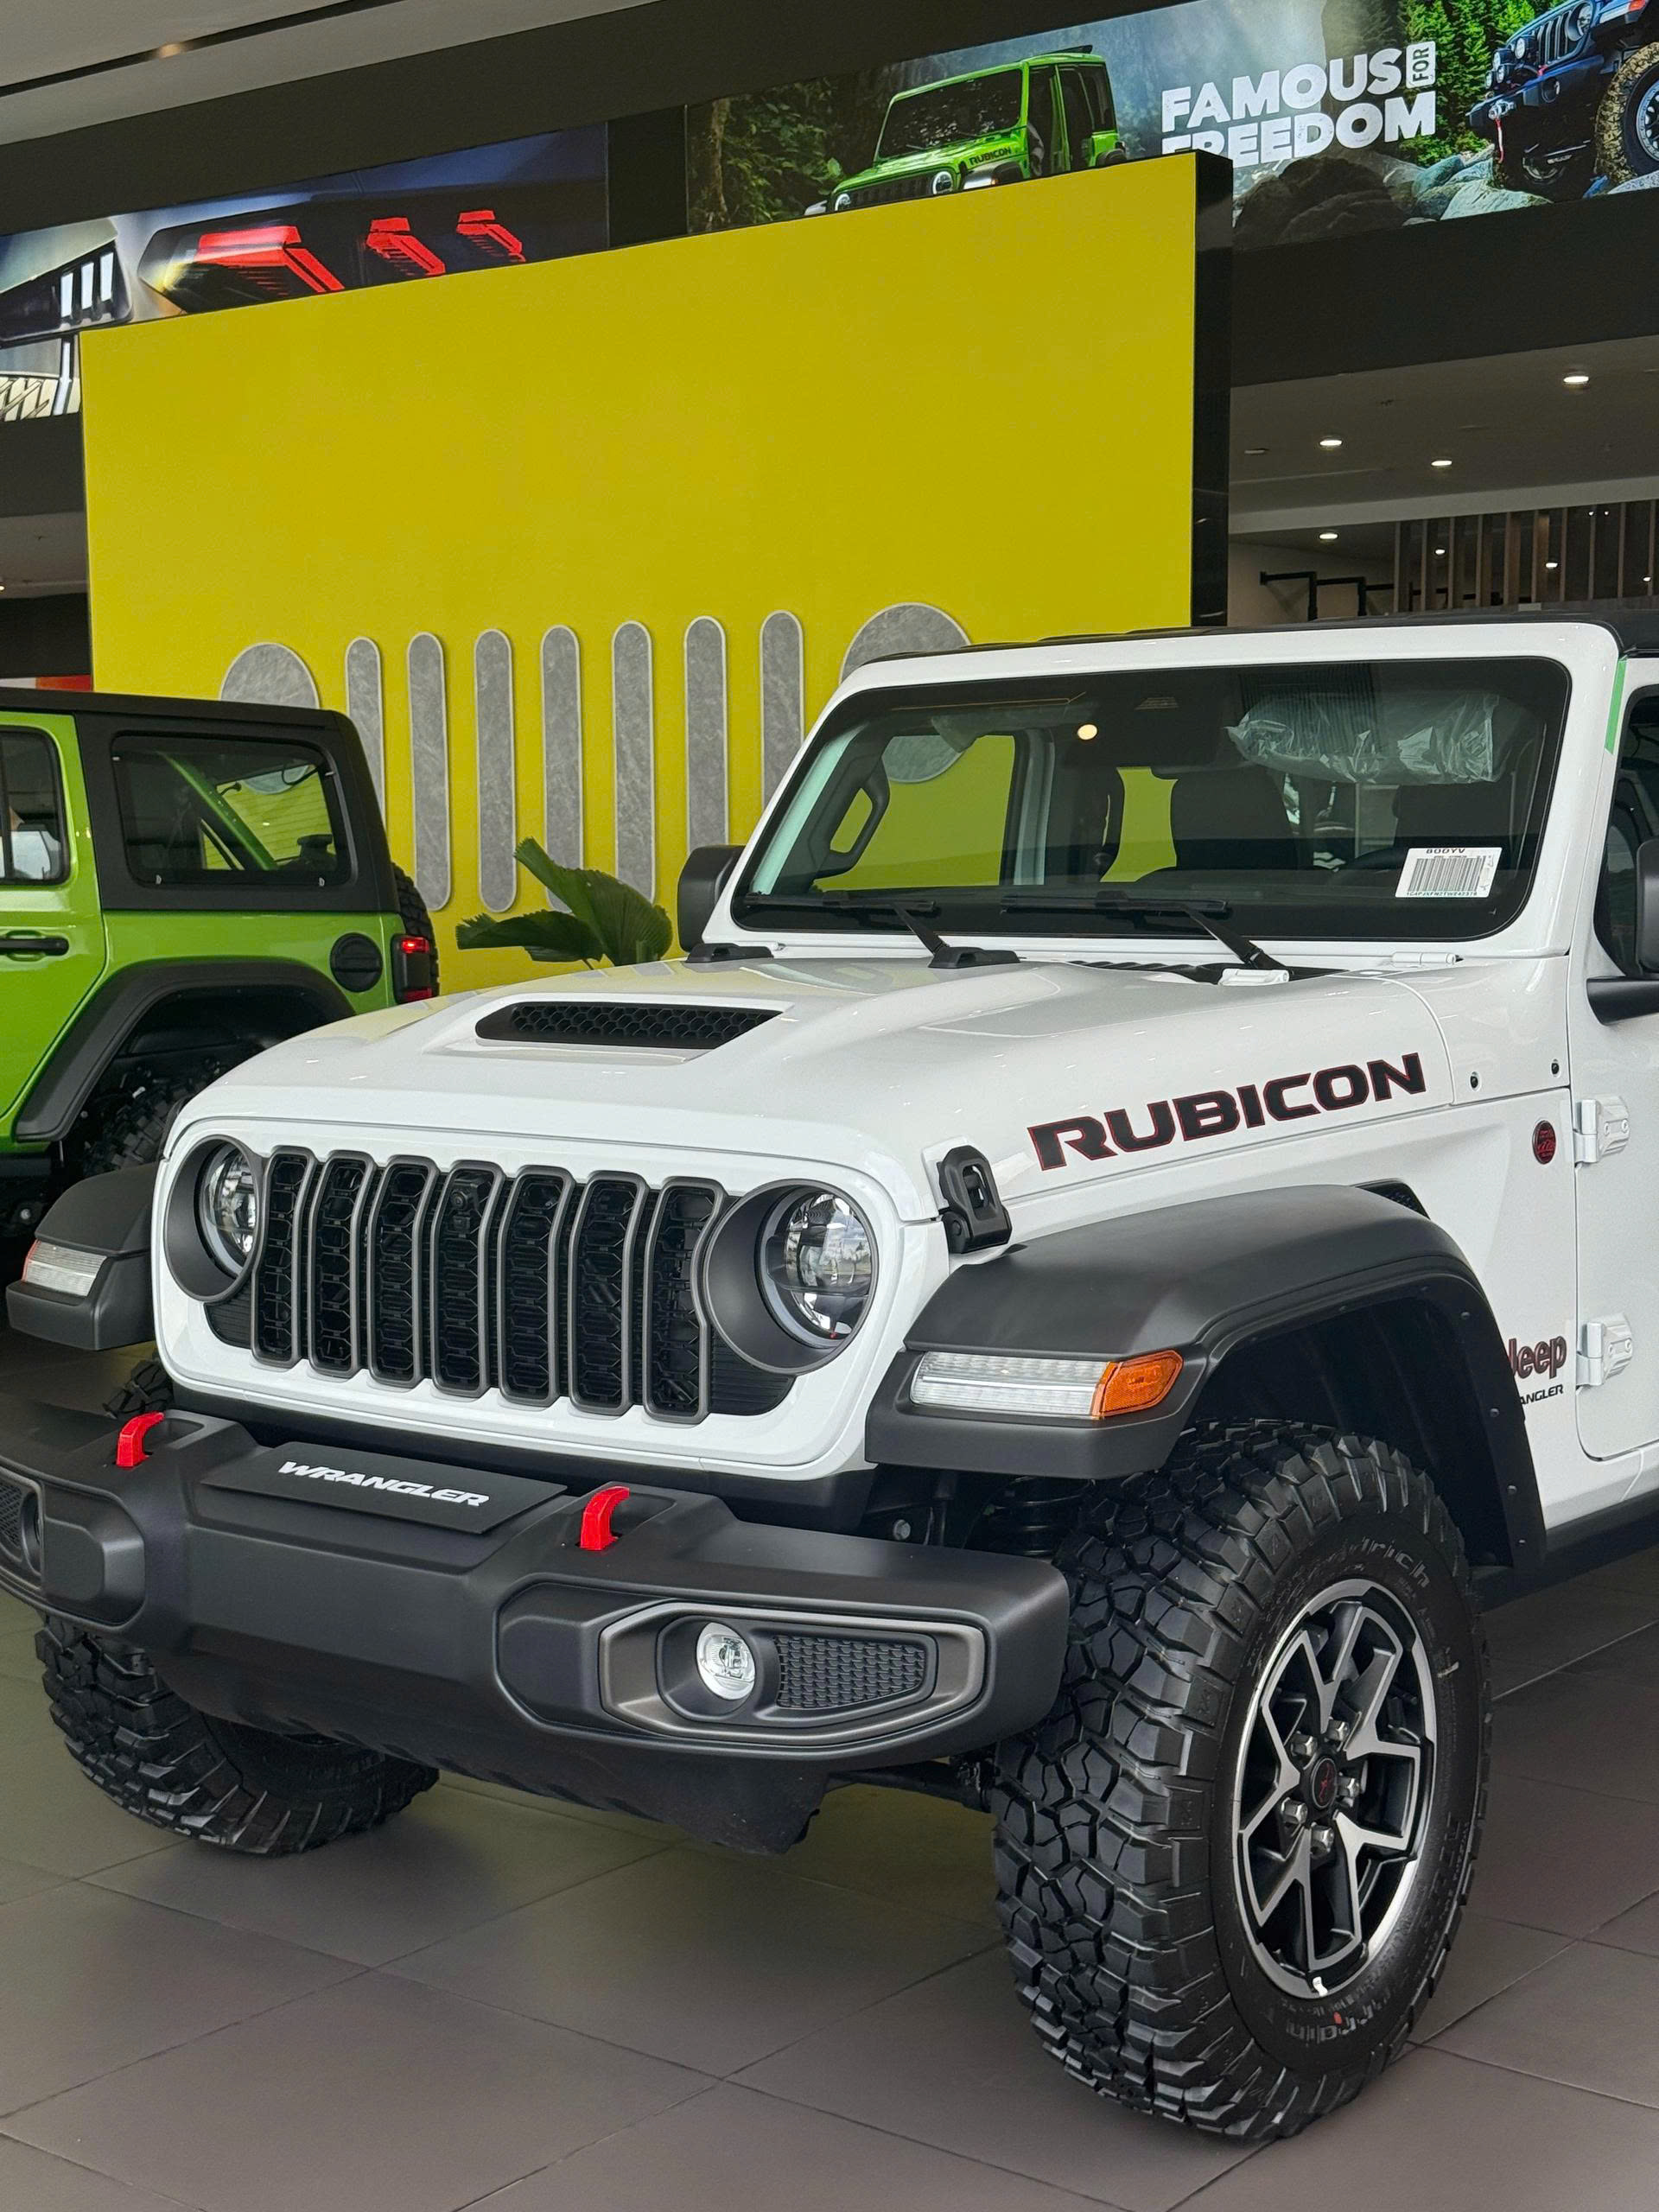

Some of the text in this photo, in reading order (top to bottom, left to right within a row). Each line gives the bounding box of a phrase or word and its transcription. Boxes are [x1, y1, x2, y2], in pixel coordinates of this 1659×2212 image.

[1412, 47, 1429, 82] FOR
[1161, 48, 1402, 132] FAMOUS
[969, 145, 1012, 165] RUBICON
[1027, 1052, 1427, 1172] RUBICON
[1521, 1383, 1564, 1405] ANGLER
[277, 1460, 490, 1507] WRANGLER
